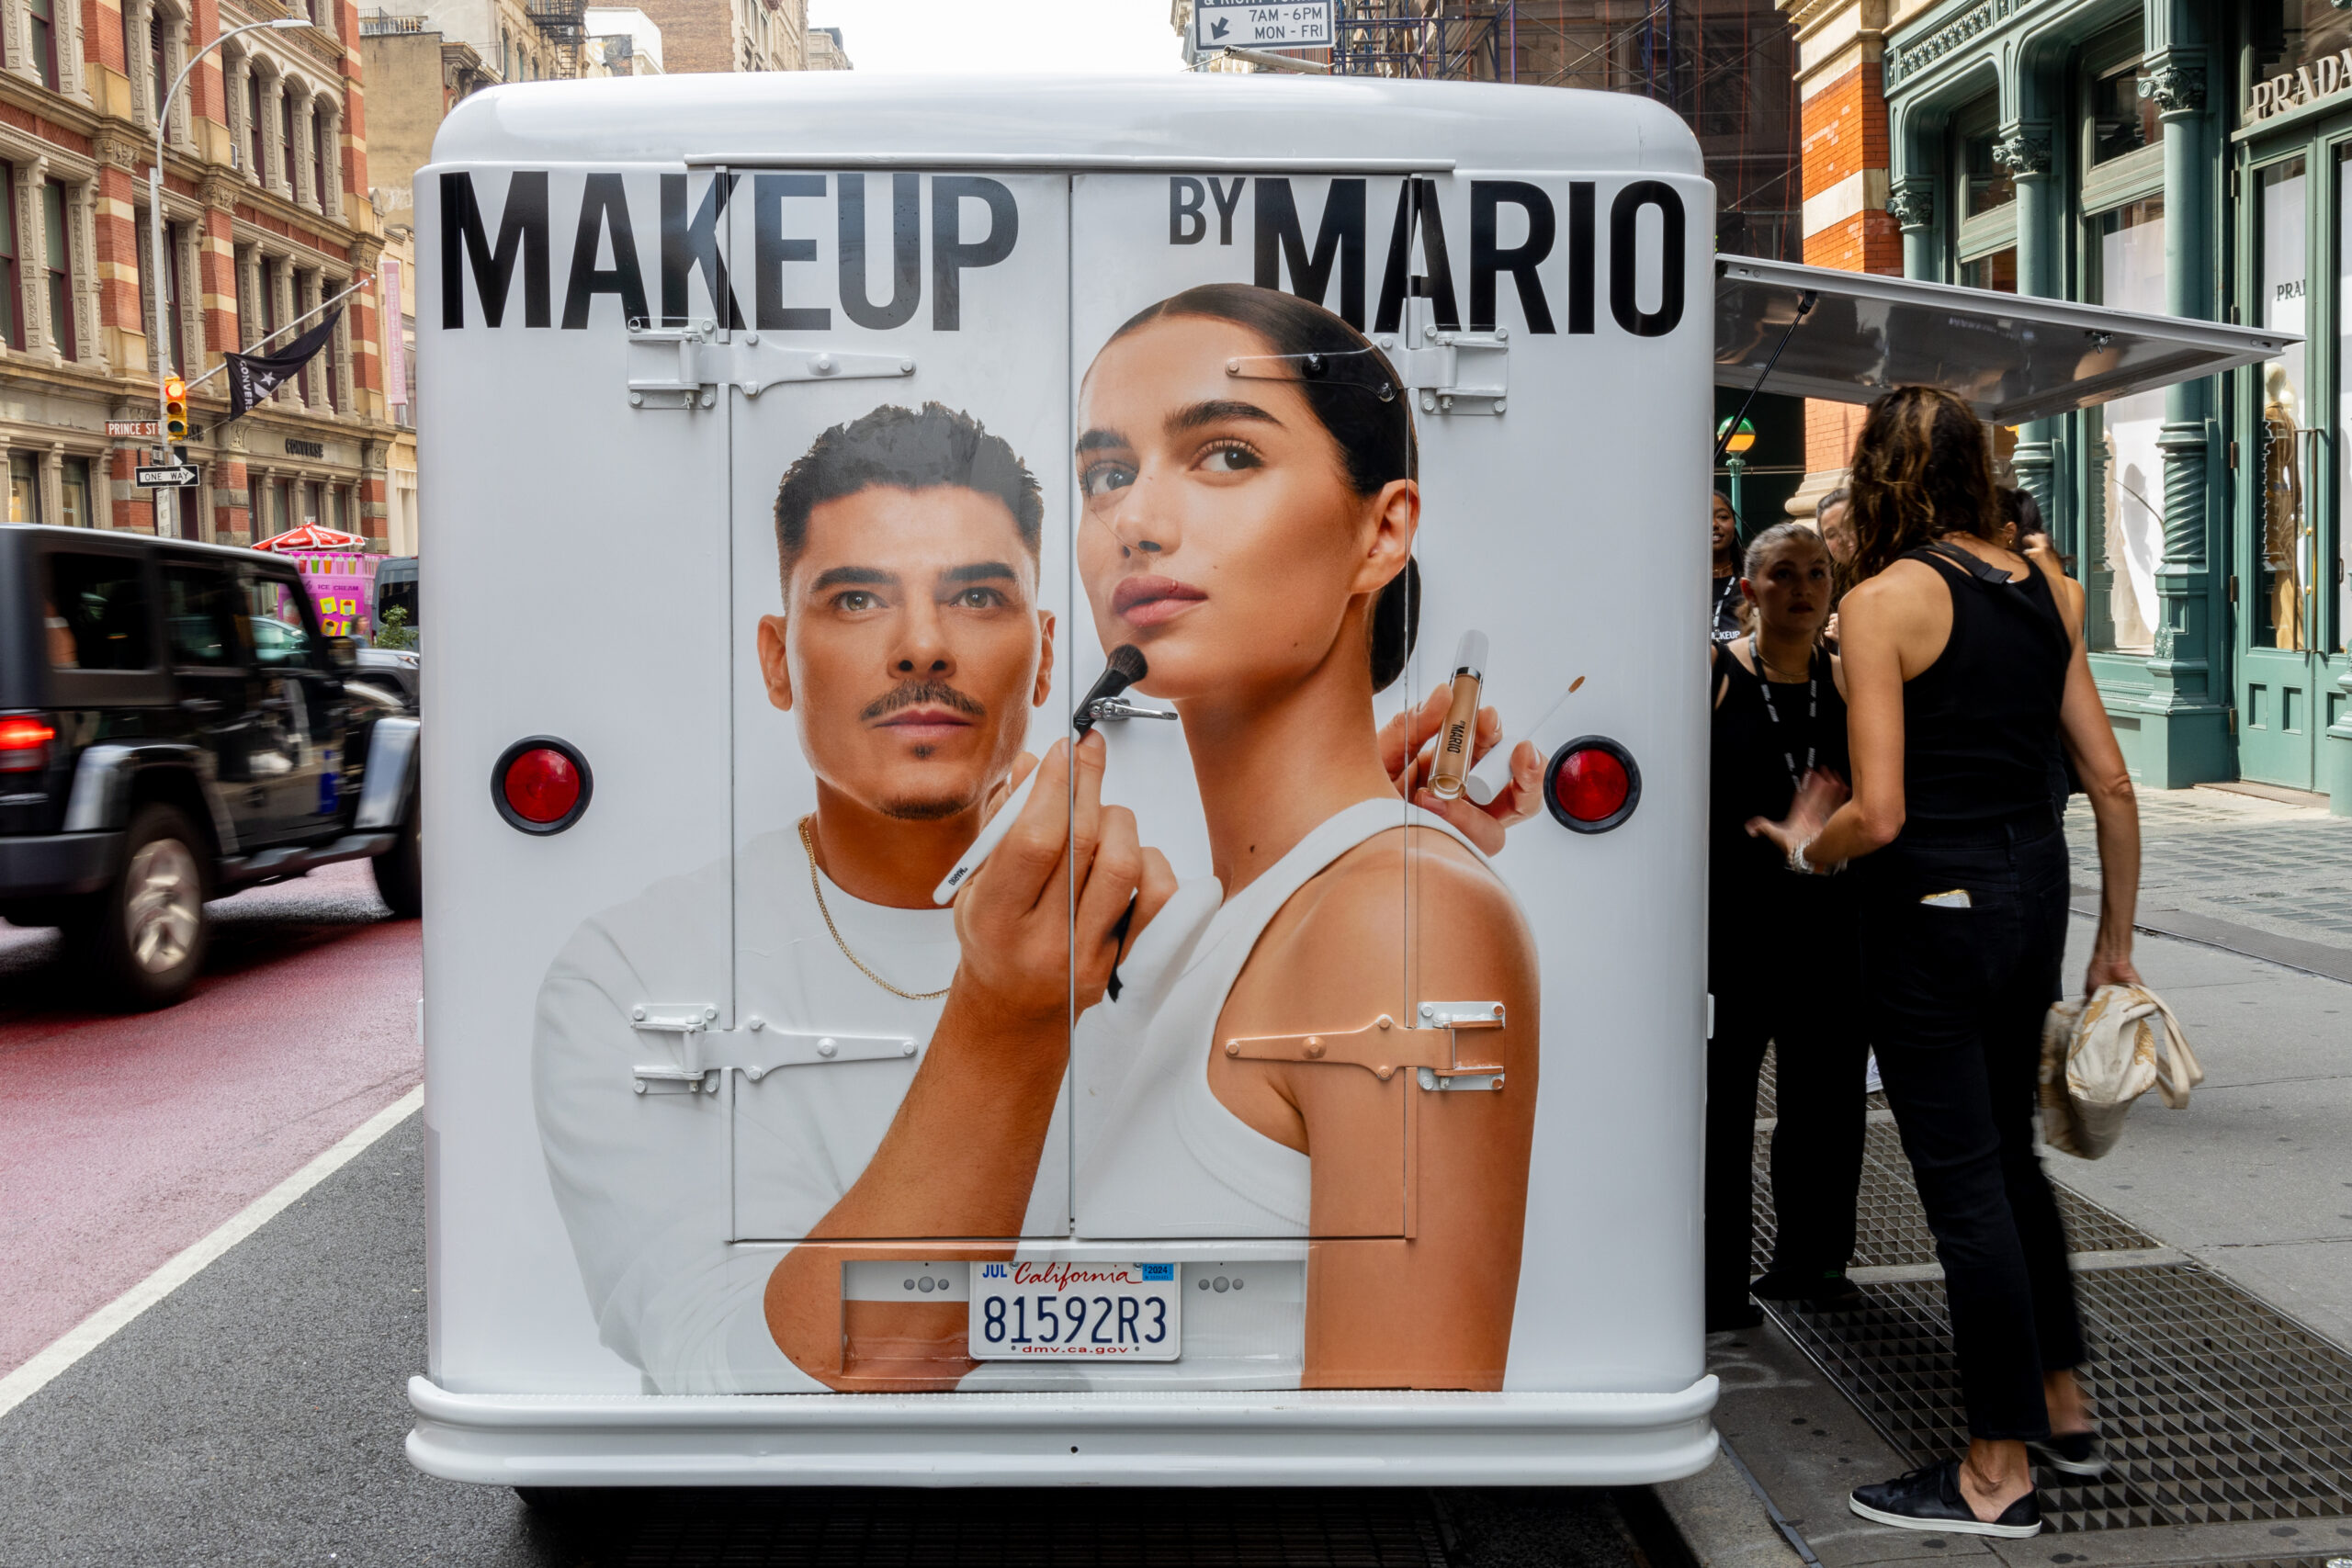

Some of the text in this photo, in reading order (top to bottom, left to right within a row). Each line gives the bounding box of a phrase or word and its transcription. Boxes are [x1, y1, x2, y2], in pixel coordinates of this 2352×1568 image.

[1250, 9, 1279, 22] 7AM
[1293, 7, 1322, 20] 6PM
[1255, 26, 1284, 39] MON
[1302, 25, 1323, 38] FRI
[2251, 48, 2352, 125] PRADA
[439, 170, 1686, 337] MAKEUP BY MARIO
[108, 423, 156, 435] PRINCE ST
[286, 438, 323, 458] CONVERSE
[1447, 724, 1464, 753] MARIO
[983, 1264, 1007, 1278] JUL
[1014, 1262, 1142, 1292] California
[984, 1296, 1166, 1343] 81592R3
[1022, 1346, 1128, 1354] dmv.ca.gov
